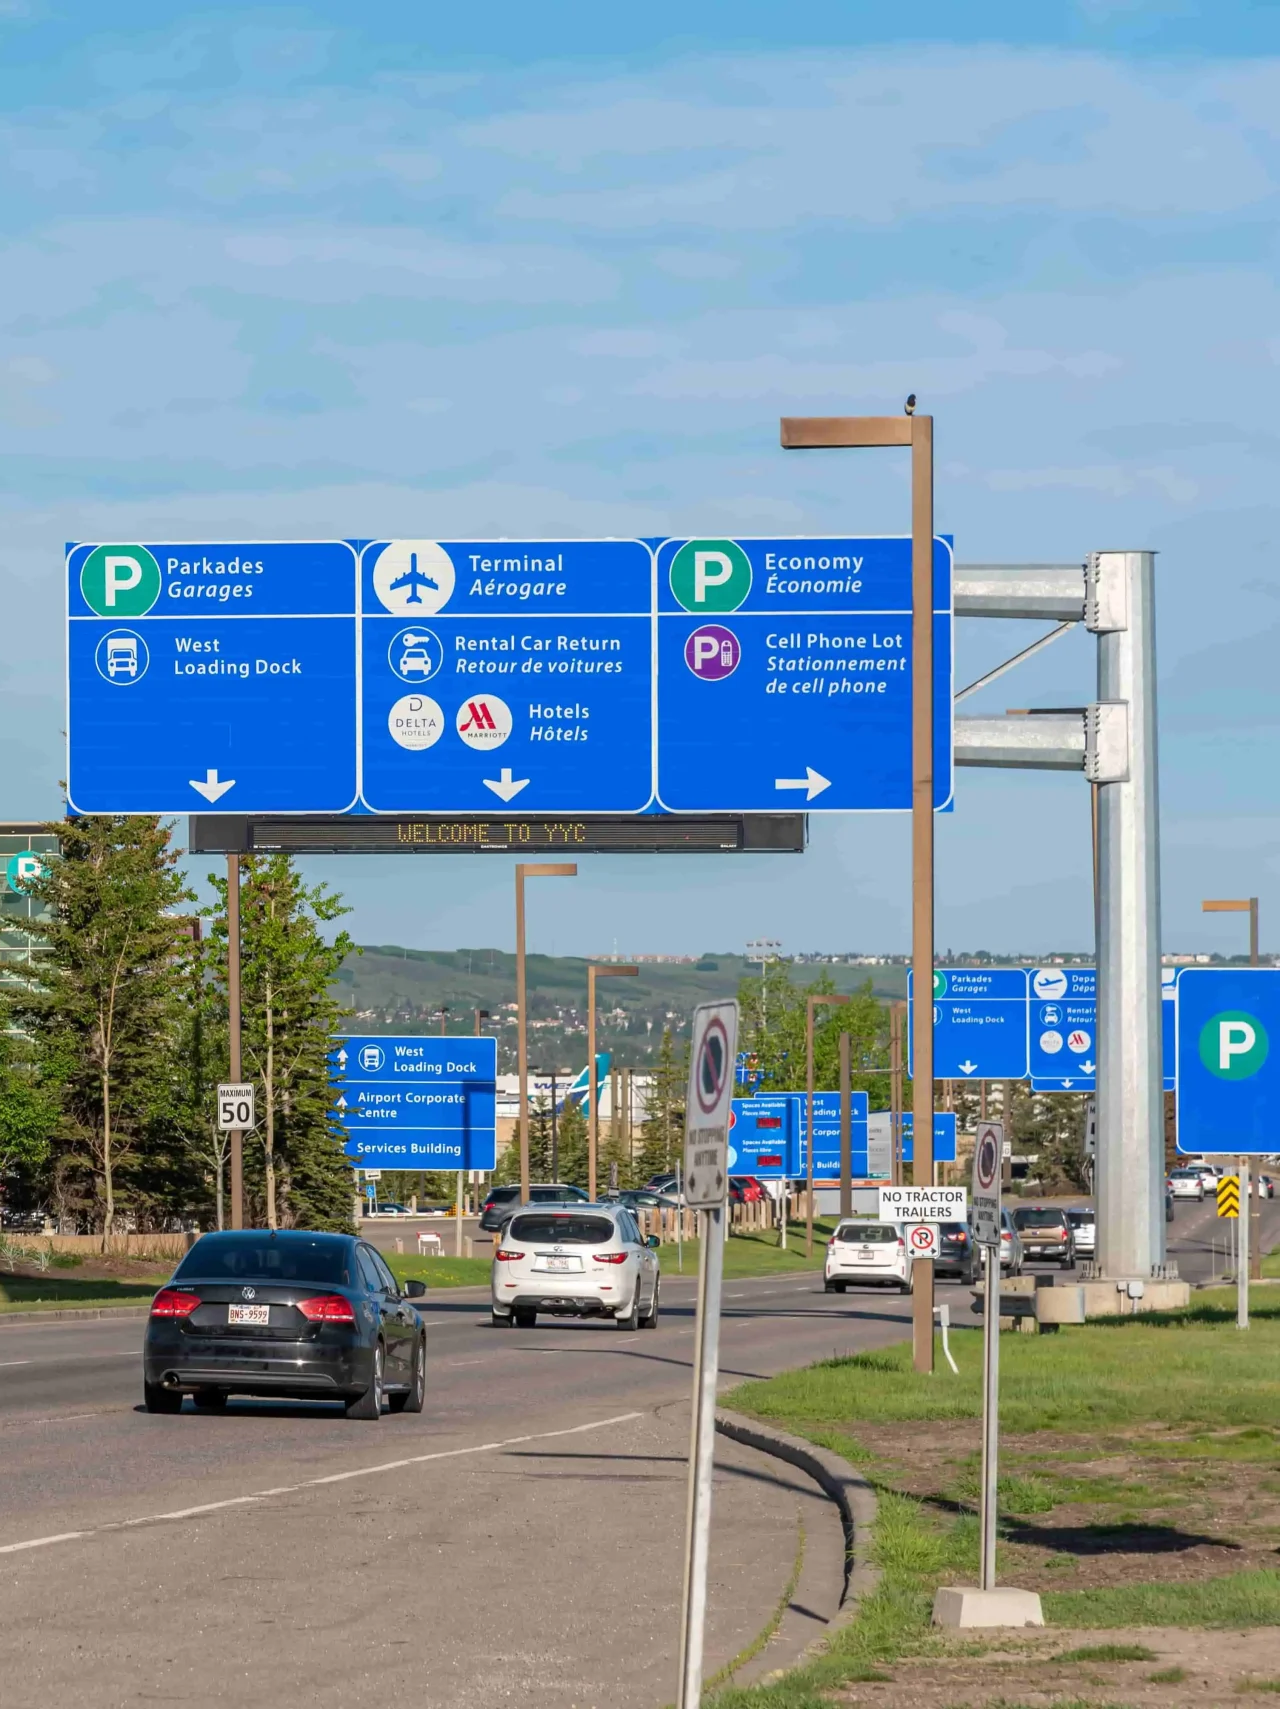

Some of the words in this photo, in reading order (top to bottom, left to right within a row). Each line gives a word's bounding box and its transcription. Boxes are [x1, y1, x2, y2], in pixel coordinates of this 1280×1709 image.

[167, 557, 264, 575] Parkades
[469, 554, 563, 572] Terminal
[765, 553, 864, 574] Economy
[105, 556, 142, 606] P
[694, 551, 733, 603] P
[765, 573, 863, 594] Économie
[168, 581, 253, 602] Garages
[469, 577, 567, 600] Aérogare
[175, 638, 220, 653] West
[455, 635, 515, 651] Rental
[520, 635, 553, 651] Car
[557, 635, 621, 651] Return
[765, 632, 801, 649] Cell
[807, 632, 867, 649] Phone
[872, 633, 903, 649] Lot
[694, 636, 720, 670] P
[174, 658, 250, 679] Loading
[256, 658, 302, 675] Dock
[456, 658, 516, 674] Retour
[521, 657, 544, 674] de
[548, 658, 623, 674] voitures
[766, 655, 907, 672] Stationnement
[765, 677, 788, 694] de
[792, 677, 825, 694] cell
[827, 678, 887, 697] phone
[529, 703, 590, 719] Hotels
[395, 718, 437, 728] DELTA
[529, 723, 588, 742] Hôtels
[398, 824, 489, 843] WELCOME
[504, 824, 530, 843] TO
[544, 824, 586, 843] YYC
[951, 975, 992, 983] Parkades
[952, 984, 987, 993] Garages
[952, 1016, 983, 1025] Loading
[394, 1046, 424, 1057] West
[1219, 1021, 1256, 1069] P
[394, 1061, 442, 1075] Loading
[446, 1061, 477, 1073] Dock
[220, 1089, 252, 1097] MAXIMUM
[358, 1092, 401, 1105] Airport
[405, 1092, 466, 1105] Corporate
[222, 1101, 250, 1123] 50
[358, 1107, 397, 1118] Centre
[804, 1108, 837, 1117] Lading
[812, 1128, 840, 1137] Corpor
[356, 1142, 407, 1154] Services
[410, 1142, 461, 1156] Building
[816, 1161, 840, 1169] Buildi
[882, 1191, 902, 1202] NO
[905, 1191, 963, 1203] TRACTOR
[894, 1206, 952, 1218] TRAILERS
[230, 1309, 268, 1320] BNS-9599
